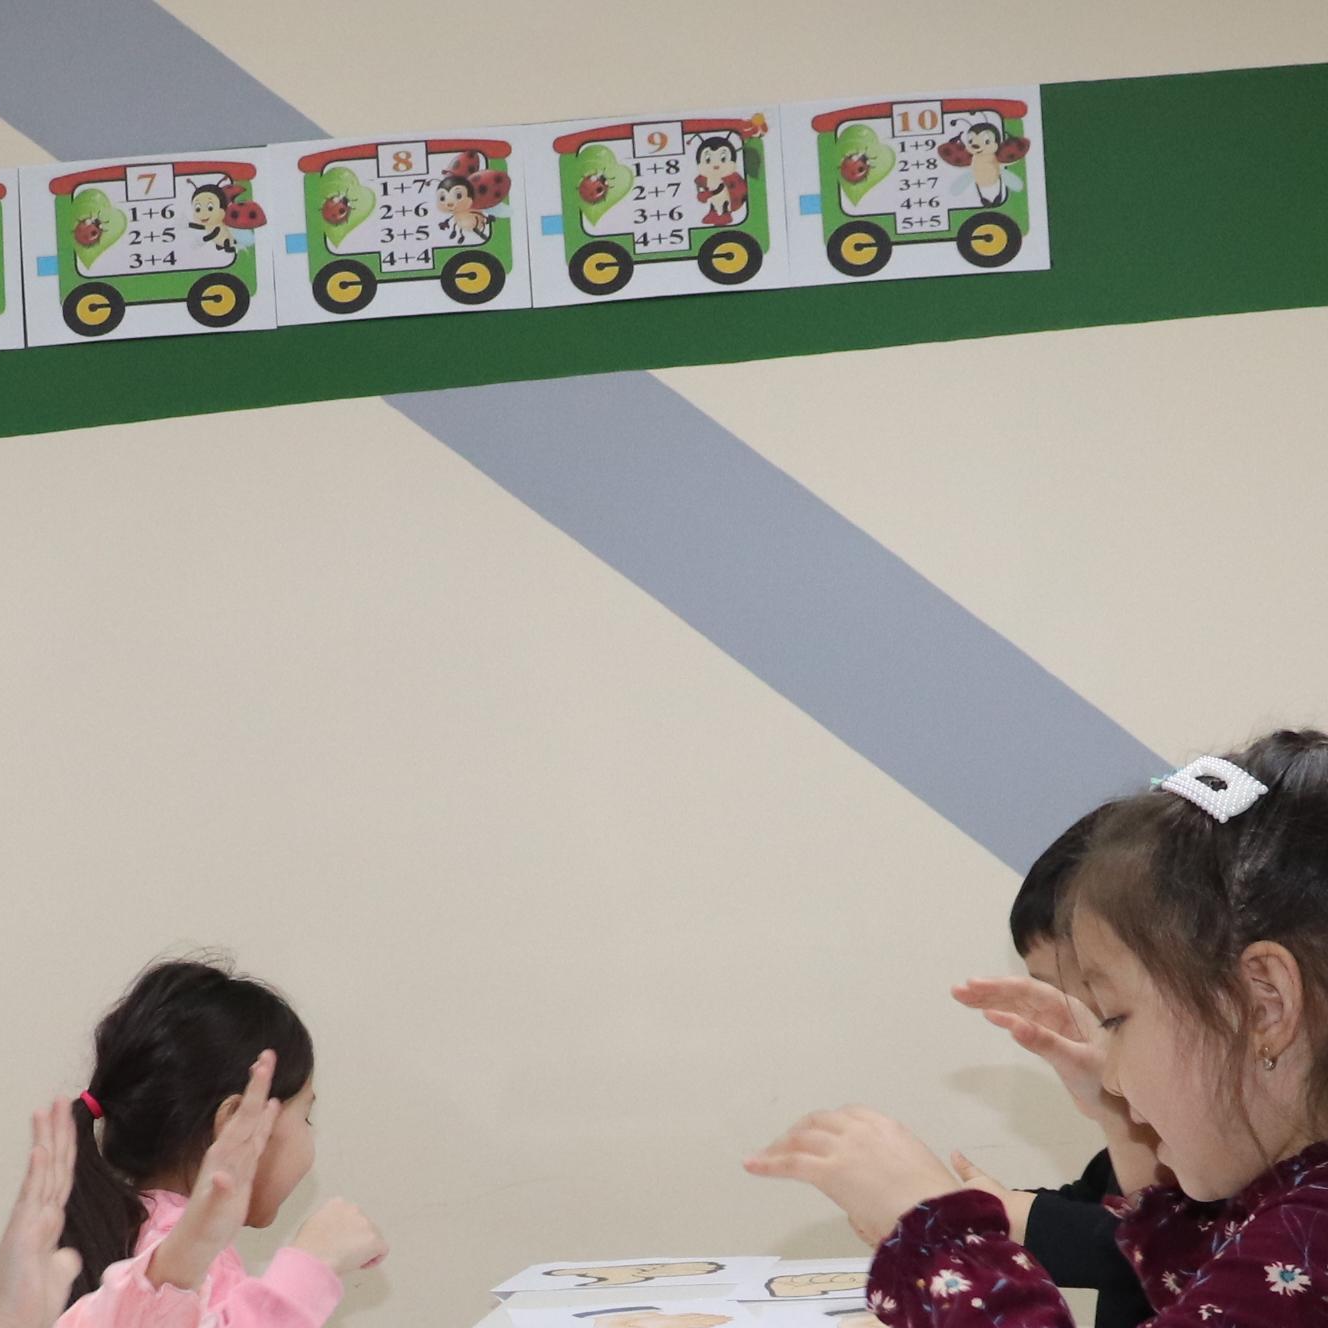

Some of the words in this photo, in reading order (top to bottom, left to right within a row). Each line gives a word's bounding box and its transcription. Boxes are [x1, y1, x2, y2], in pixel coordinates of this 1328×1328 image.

[898, 109, 938, 133] 10
[647, 131, 668, 154] 9
[898, 139, 937, 153] 1+9
[392, 150, 413, 172] 8
[633, 159, 680, 177] 1+8
[898, 158, 938, 172] 2+8
[137, 173, 157, 195] 7
[380, 179, 427, 196] 1+7
[633, 182, 681, 201] 2+7
[899, 177, 938, 191] 3+7
[379, 201, 429, 220] 2+6
[900, 195, 940, 210] 4+6
[130, 203, 175, 222] 1+6
[633, 205, 684, 224] 3+6
[902, 215, 942, 230] 5+5
[129, 227, 176, 245] 2+5
[380, 225, 430, 243] 3+5
[635, 229, 685, 247] 4+5
[129, 250, 177, 269] 3+4
[382, 249, 431, 266] 4+4
